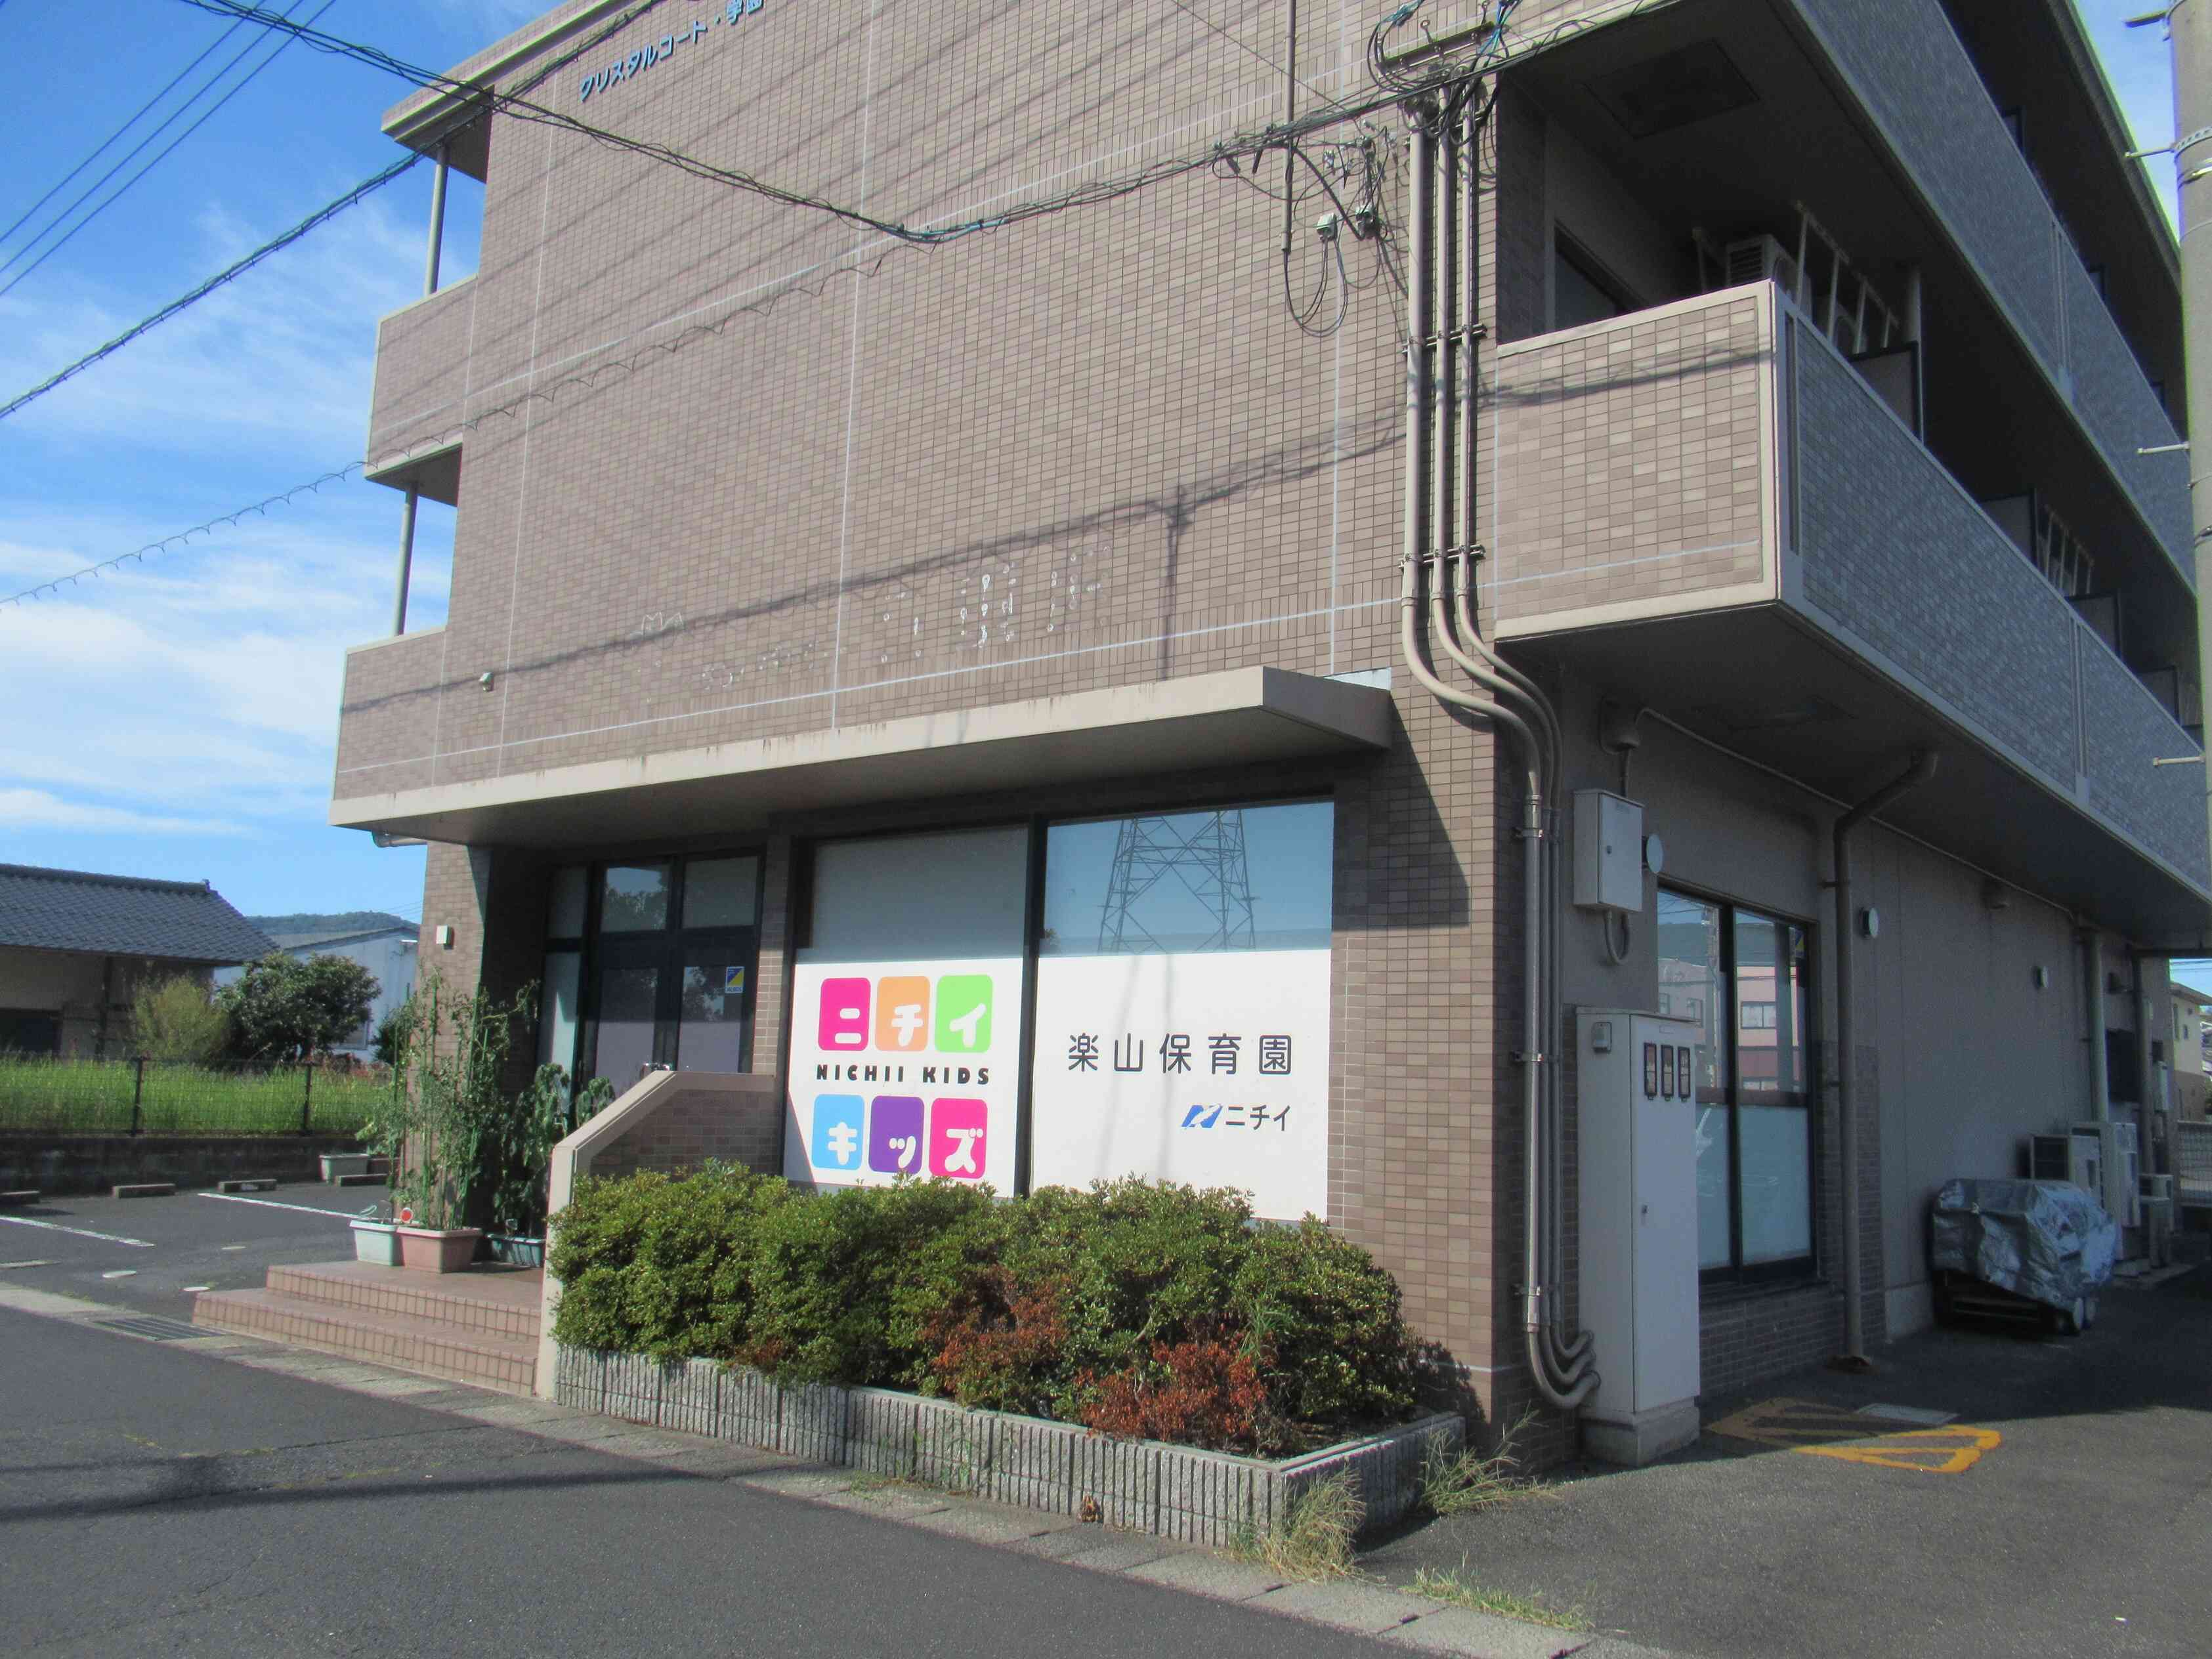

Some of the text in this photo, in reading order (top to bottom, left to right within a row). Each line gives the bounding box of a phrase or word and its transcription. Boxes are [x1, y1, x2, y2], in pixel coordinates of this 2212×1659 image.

[834, 1003, 987, 1047] ニチイ
[816, 1064, 990, 1085] NICHII KIDS
[1068, 1032, 1292, 1075] 楽山保育園
[1225, 1104, 1290, 1131] ニチイ
[827, 1122, 984, 1174] キッズ
